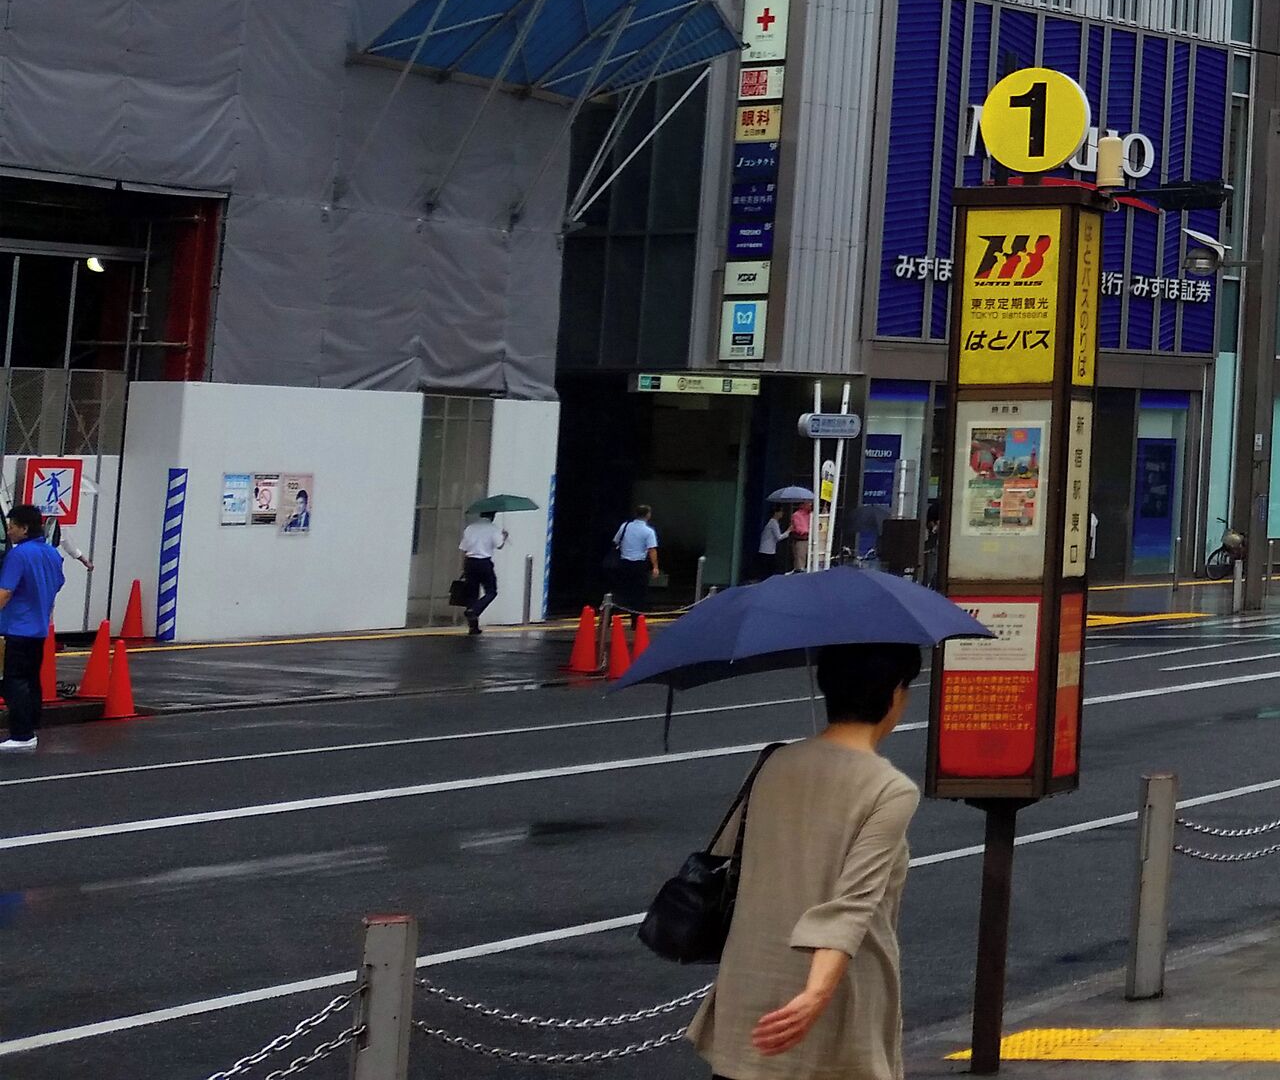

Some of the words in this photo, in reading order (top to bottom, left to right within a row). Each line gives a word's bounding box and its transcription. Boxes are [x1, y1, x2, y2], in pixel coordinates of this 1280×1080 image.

[741, 110, 770, 126] 眼科
[1009, 82, 1048, 158] 1
[1078, 221, 1093, 379] はとバスのりば
[1133, 275, 1212, 303] みずほ証券
[970, 297, 1050, 310] 東京定期観光
[964, 329, 1051, 351] はとバス
